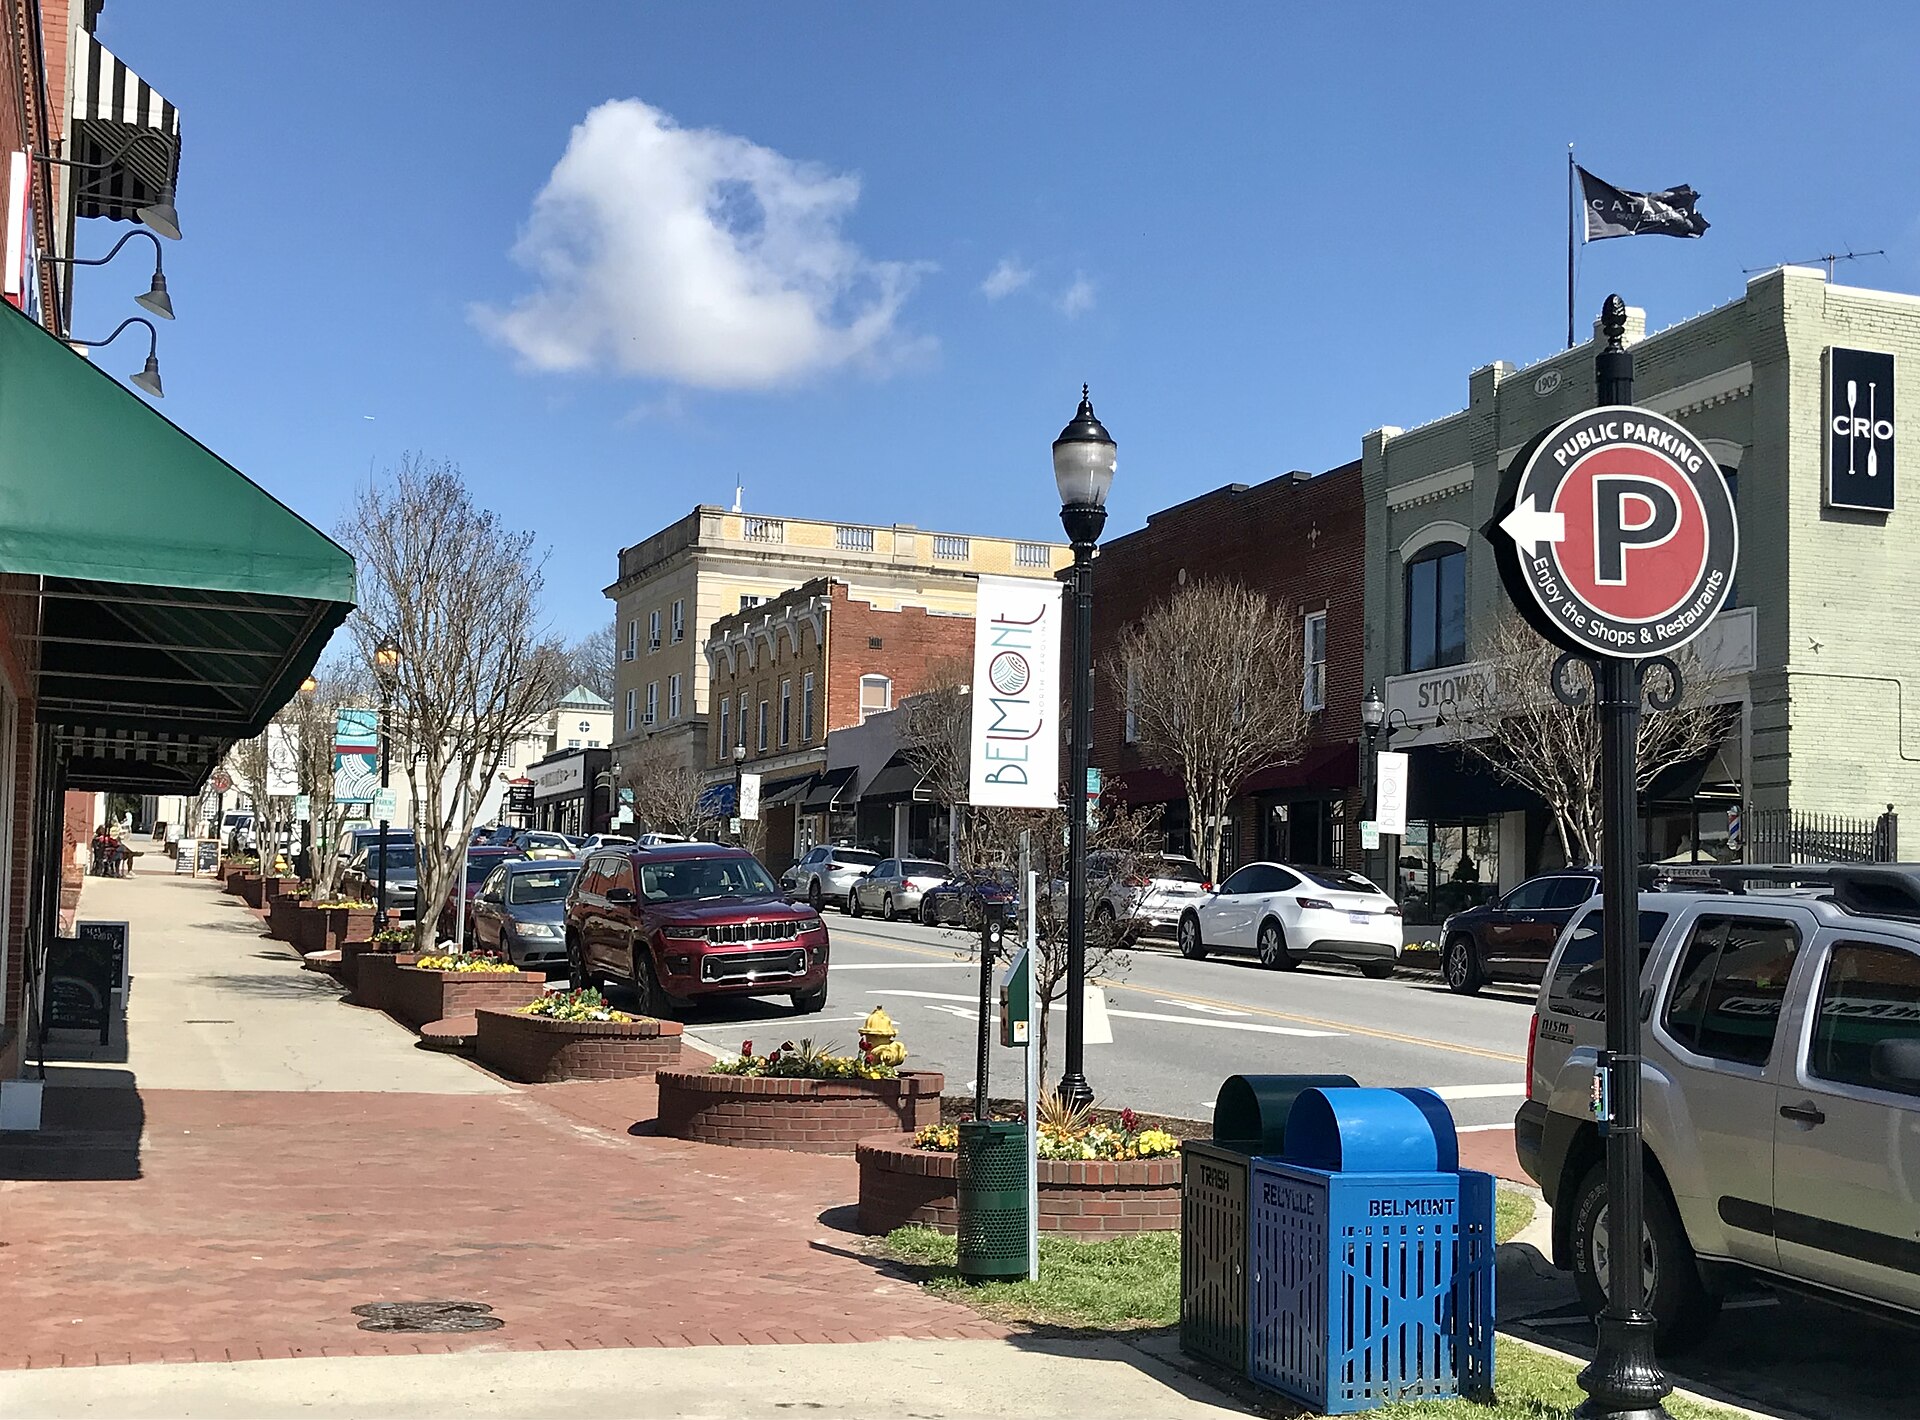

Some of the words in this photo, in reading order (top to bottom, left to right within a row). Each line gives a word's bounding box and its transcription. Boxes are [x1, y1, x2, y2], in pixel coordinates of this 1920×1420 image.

[1553, 422, 1619, 467] PUBLIC
[1623, 421, 1703, 474] PARKING
[1591, 473, 1683, 587] P
[1532, 556, 1564, 604] Enjoy
[1560, 600, 1587, 629] the
[1587, 620, 1636, 648] Shops
[1639, 627, 1654, 645] &
[1655, 568, 1724, 641] Restaurants
[1200, 1164, 1230, 1192] TRASH
[1263, 1182, 1315, 1216] RECYCLE
[1369, 1198, 1456, 1218] BELMONT
